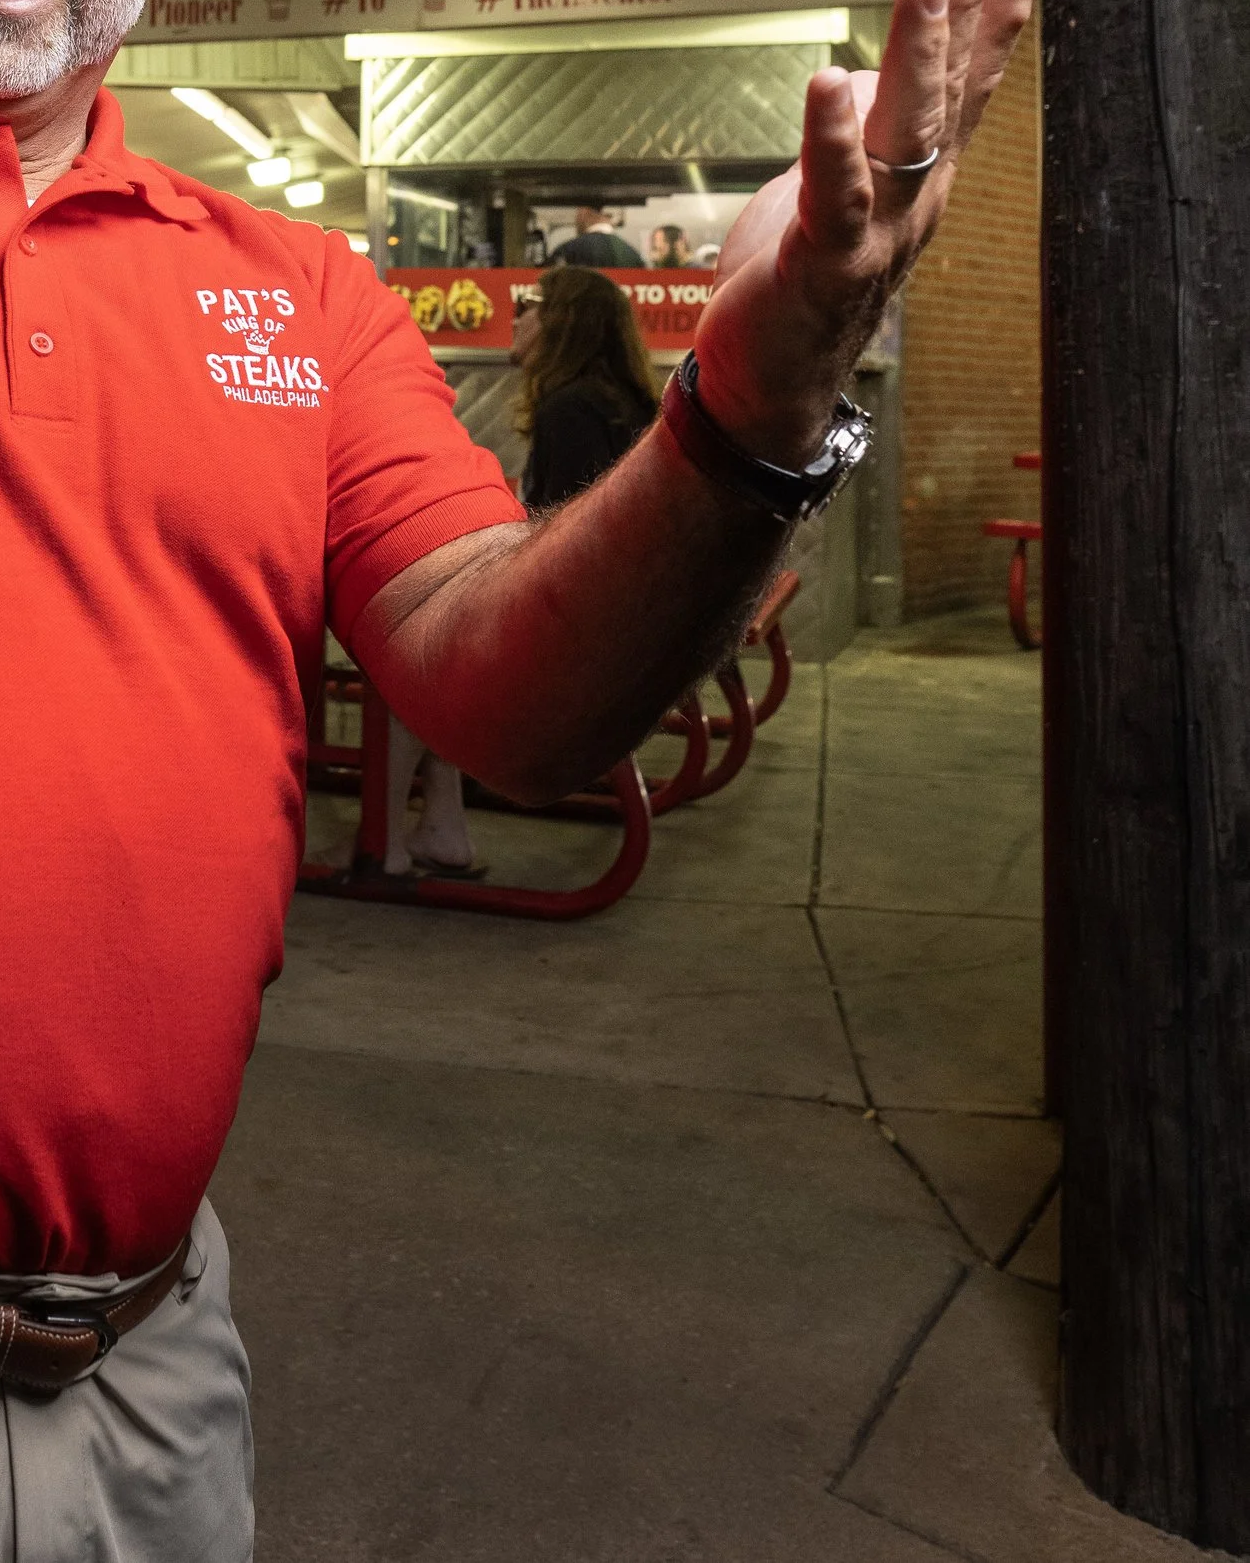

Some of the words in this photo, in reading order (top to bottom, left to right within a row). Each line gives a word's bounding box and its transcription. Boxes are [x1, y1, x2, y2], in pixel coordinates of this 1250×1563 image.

[196, 289, 295, 316] PAT'S
[635, 284, 666, 305] TO
[222, 315, 260, 334] KING
[264, 318, 286, 334] OF
[223, 385, 321, 408] PHILADELPHIA
